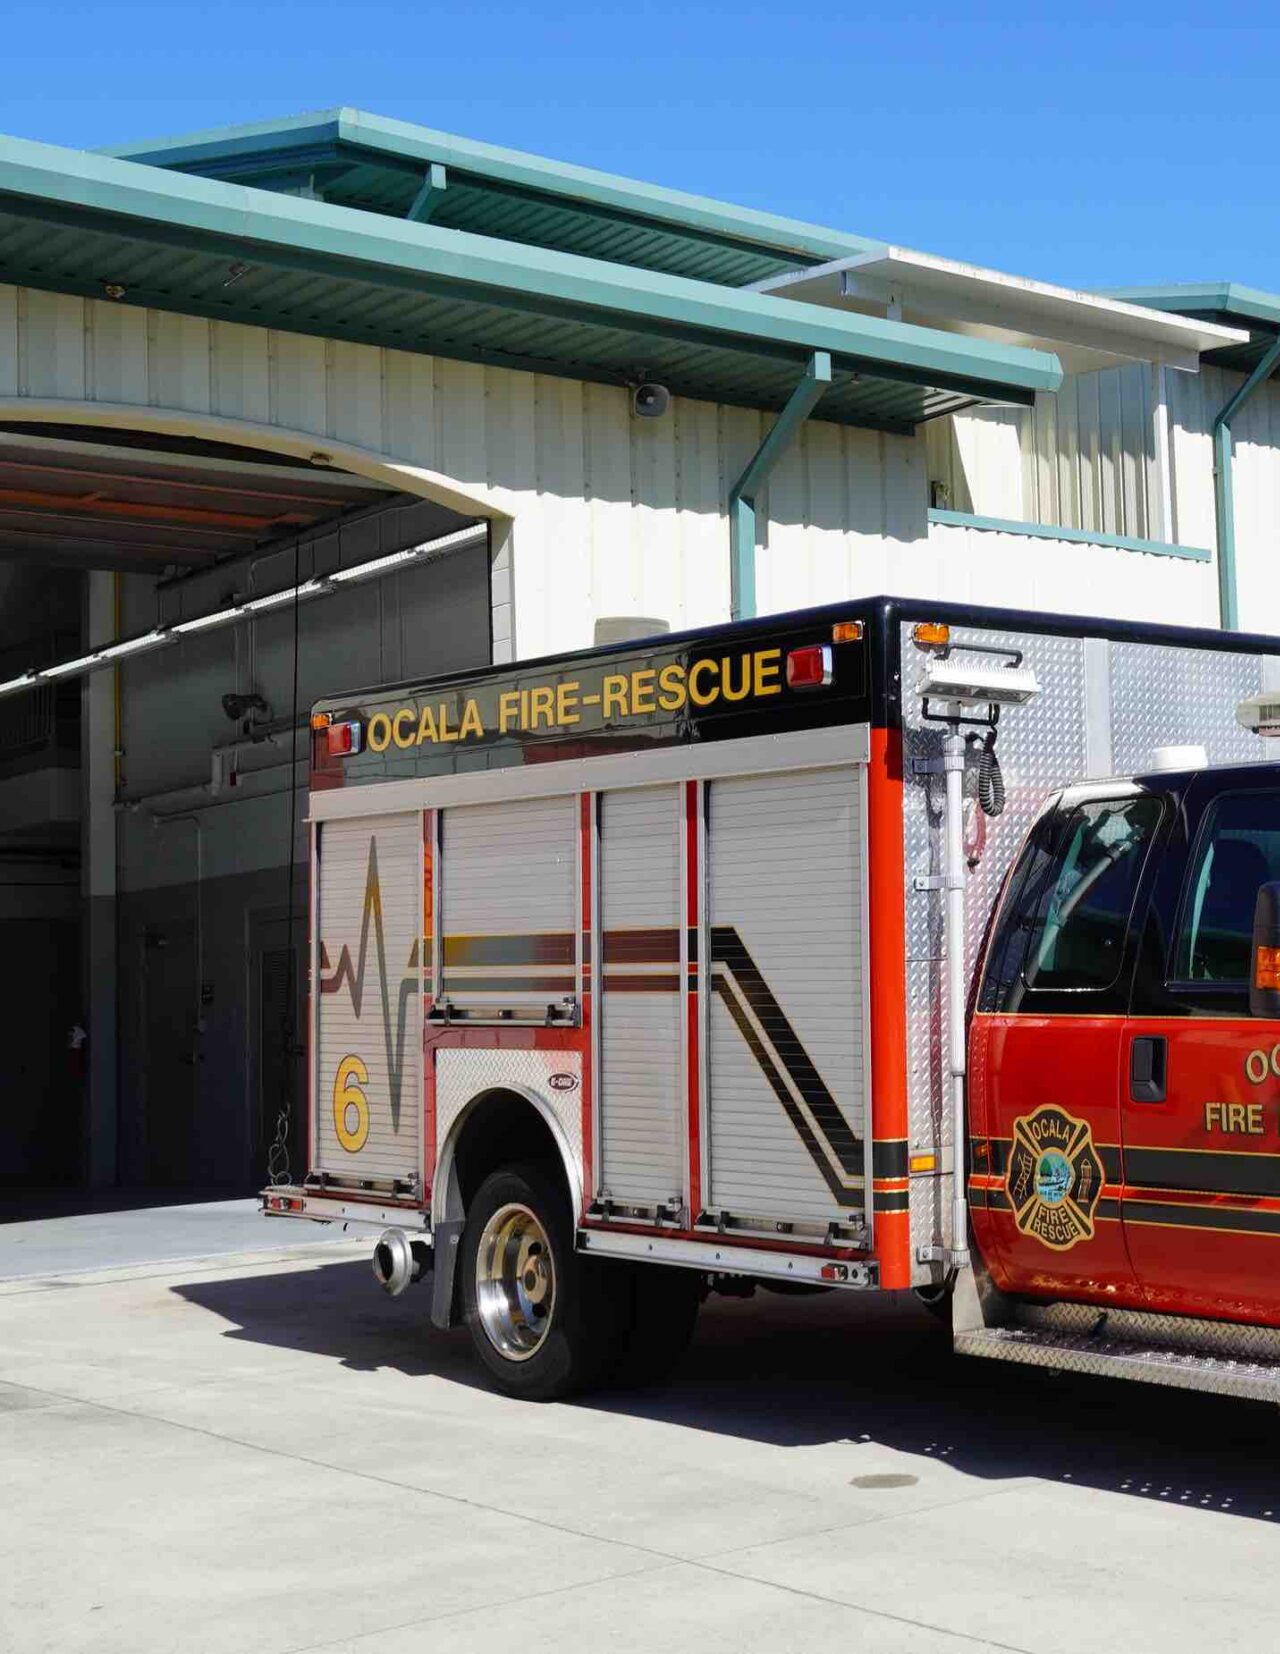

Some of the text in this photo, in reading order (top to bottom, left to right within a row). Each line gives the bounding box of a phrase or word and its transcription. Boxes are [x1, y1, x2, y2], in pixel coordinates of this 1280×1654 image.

[367, 648, 782, 752] OCALA FIRE-RESCUE
[333, 1054, 369, 1153] 6
[1032, 1118, 1071, 1142] OCALA
[1205, 1102, 1265, 1134] FIRE
[1037, 1205, 1070, 1226] FIRE
[1032, 1221, 1080, 1241] RESCUE
